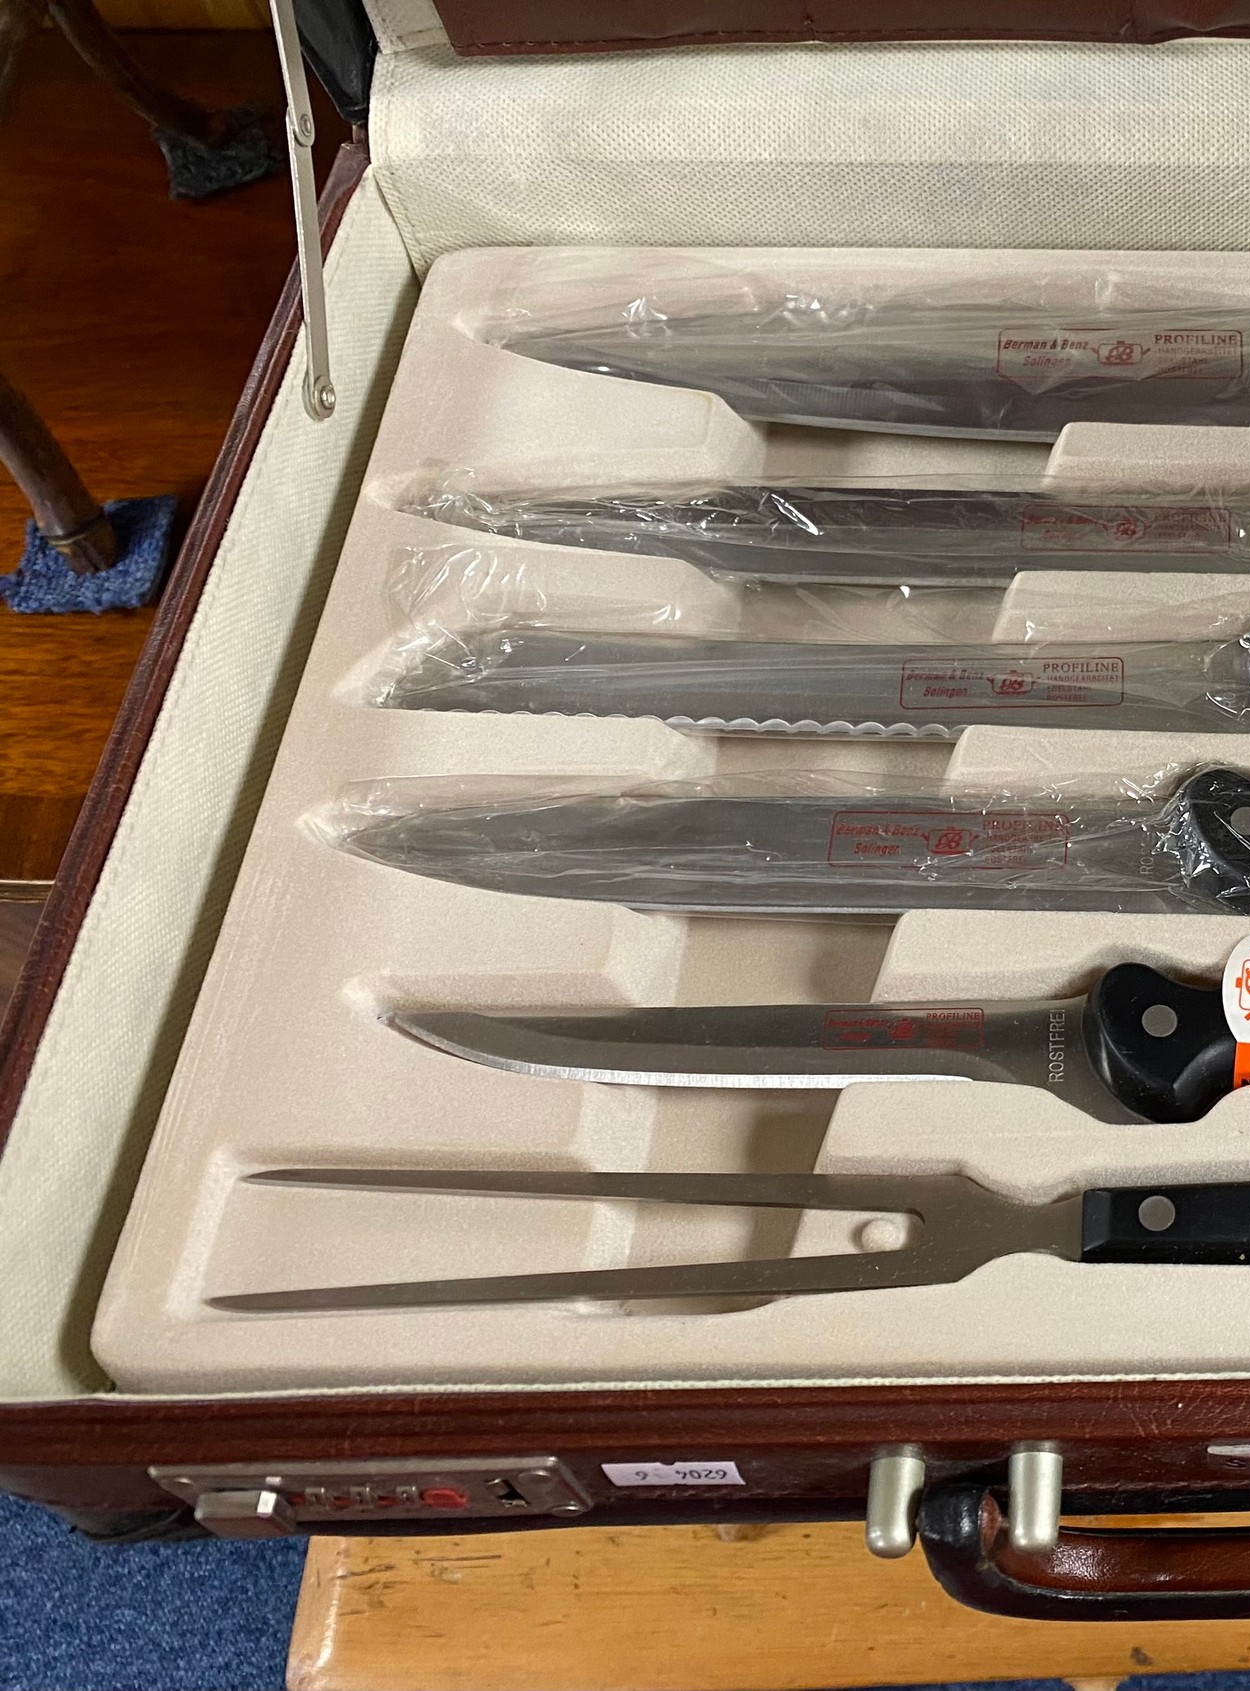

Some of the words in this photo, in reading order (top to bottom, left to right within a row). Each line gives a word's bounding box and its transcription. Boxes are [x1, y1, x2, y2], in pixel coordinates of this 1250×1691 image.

[1002, 339, 1048, 350] Berman
[1049, 339, 1058, 350] &
[1060, 339, 1090, 351] Benz
[1154, 334, 1238, 345] PROFILINE
[1042, 662, 1120, 673] PROFILINE
[922, 686, 968, 699] Solingen
[926, 1012, 980, 1021] PROFILINE
[1048, 1009, 1066, 1082] ROSTFREI
